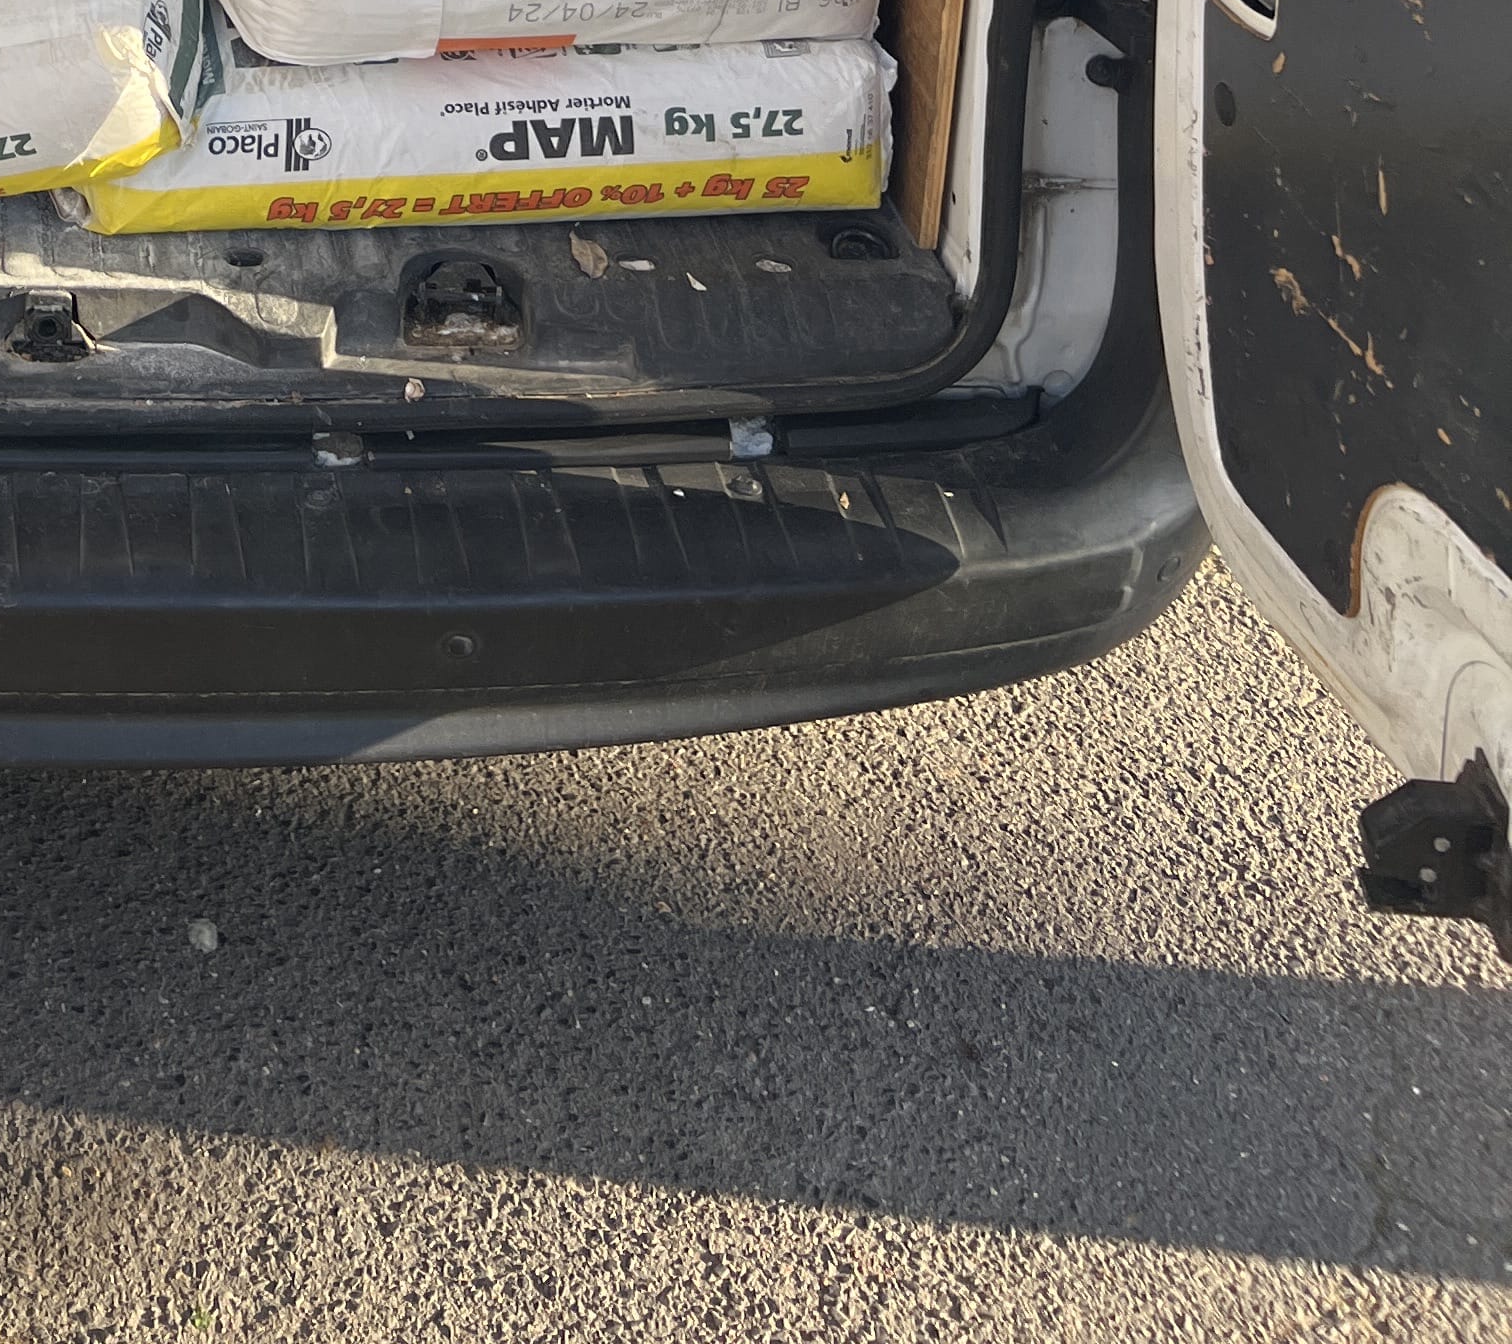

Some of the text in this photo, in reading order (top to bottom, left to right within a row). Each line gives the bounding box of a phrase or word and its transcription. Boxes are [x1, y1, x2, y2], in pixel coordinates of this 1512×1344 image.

[508, 1, 649, 23] 24/04/24
[494, 99, 560, 116] Adhésif
[565, 96, 631, 111] Mortier
[207, 123, 267, 134] SAINT-GOBAIN
[664, 107, 715, 142] kg
[730, 107, 804, 138] 27,5
[208, 134, 279, 160] Placo
[601, 183, 664, 204] 10%
[675, 181, 695, 197] +
[701, 173, 755, 200] kg
[762, 176, 809, 199] 25
[268, 198, 319, 223] kg
[329, 198, 407, 222] 27,5
[440, 188, 592, 216] OFFERT
